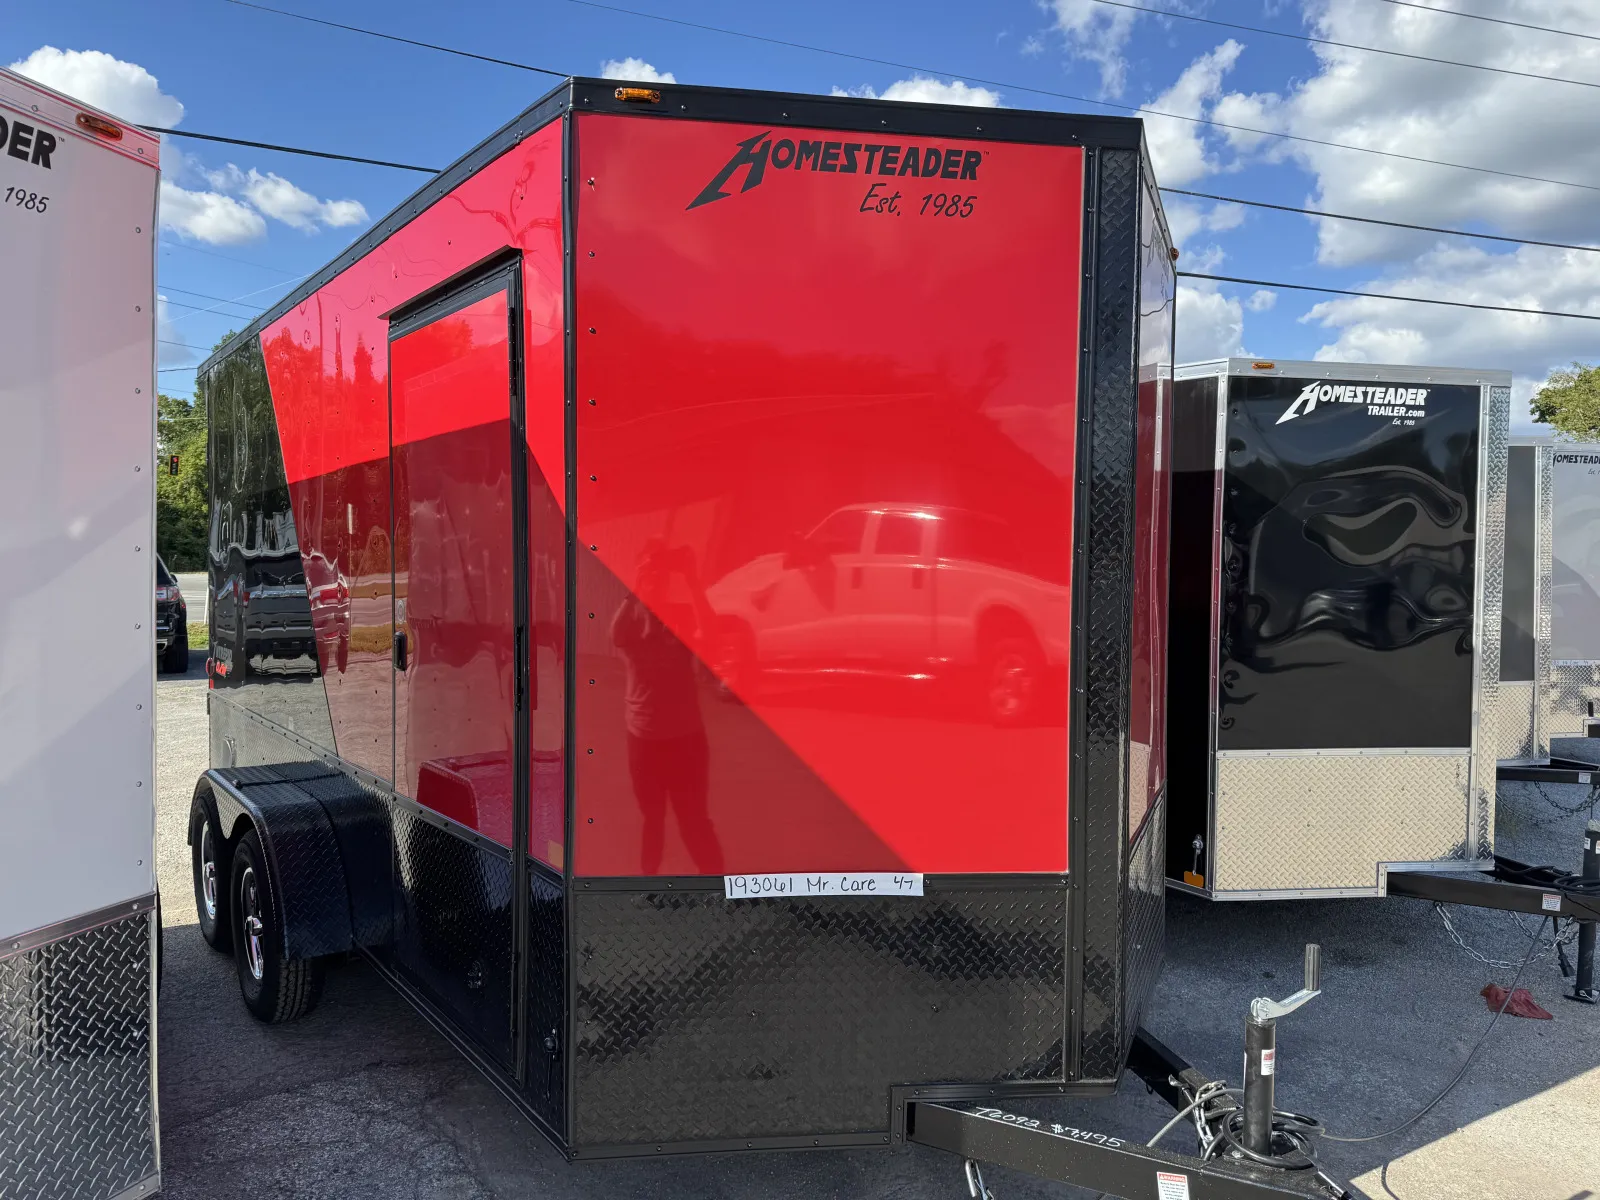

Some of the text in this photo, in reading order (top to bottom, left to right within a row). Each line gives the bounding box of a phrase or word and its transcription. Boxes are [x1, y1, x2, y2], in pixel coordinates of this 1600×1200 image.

[685, 130, 982, 211] HOMESTEADER
[5, 187, 50, 213] 1985
[860, 183, 978, 219] Est. 1985
[1275, 380, 1428, 426] HOMESTEADER
[1367, 405, 1425, 418] TRAILER.com
[728, 875, 793, 897] 193061
[806, 877, 835, 893] Mr.
[840, 876, 877, 892] Care
